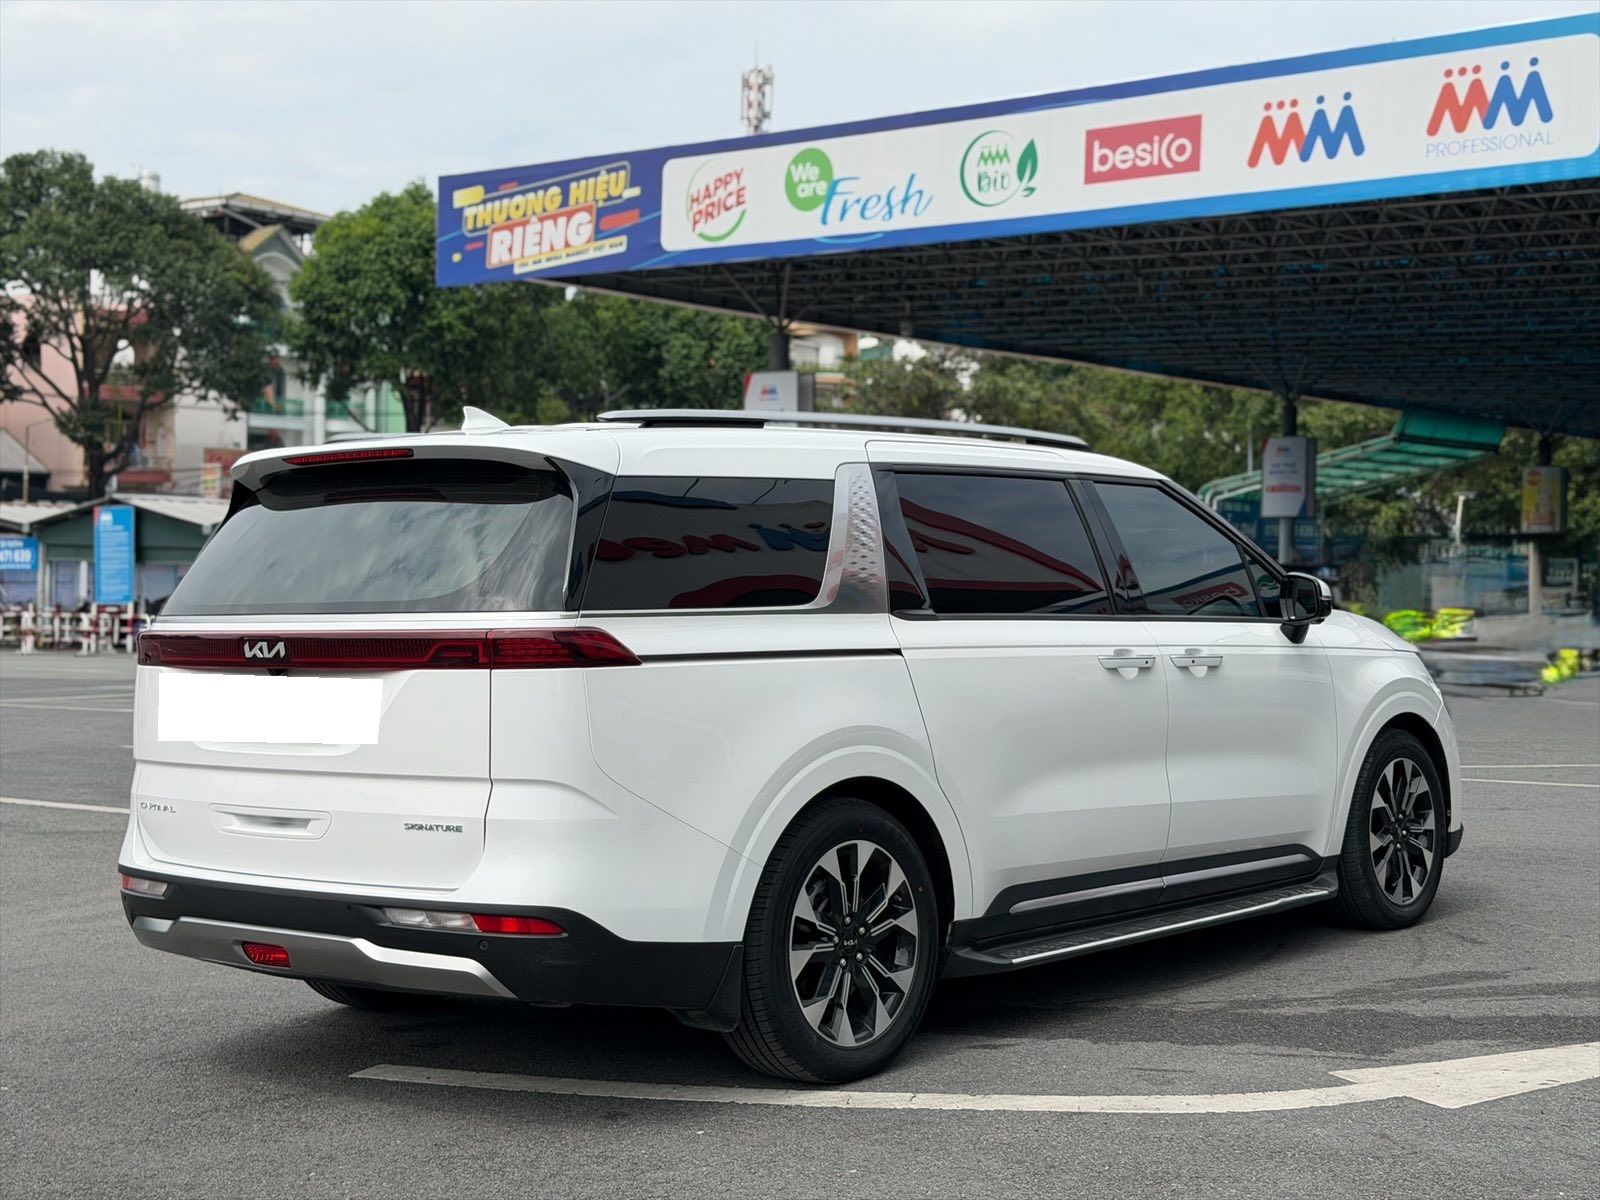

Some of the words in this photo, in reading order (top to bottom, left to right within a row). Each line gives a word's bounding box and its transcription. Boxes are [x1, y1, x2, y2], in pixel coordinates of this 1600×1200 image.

[1092, 133, 1193, 173] besico
[1426, 131, 1554, 158] PROFESSIONAL
[690, 167, 745, 211] HAPPY
[789, 161, 820, 184] We
[796, 179, 828, 198] are
[977, 170, 1011, 193] Bio
[692, 186, 747, 232] PRICE
[821, 173, 933, 226] Fresh
[490, 211, 593, 264] RIÊNG
[403, 822, 464, 834] SIGNATURE
